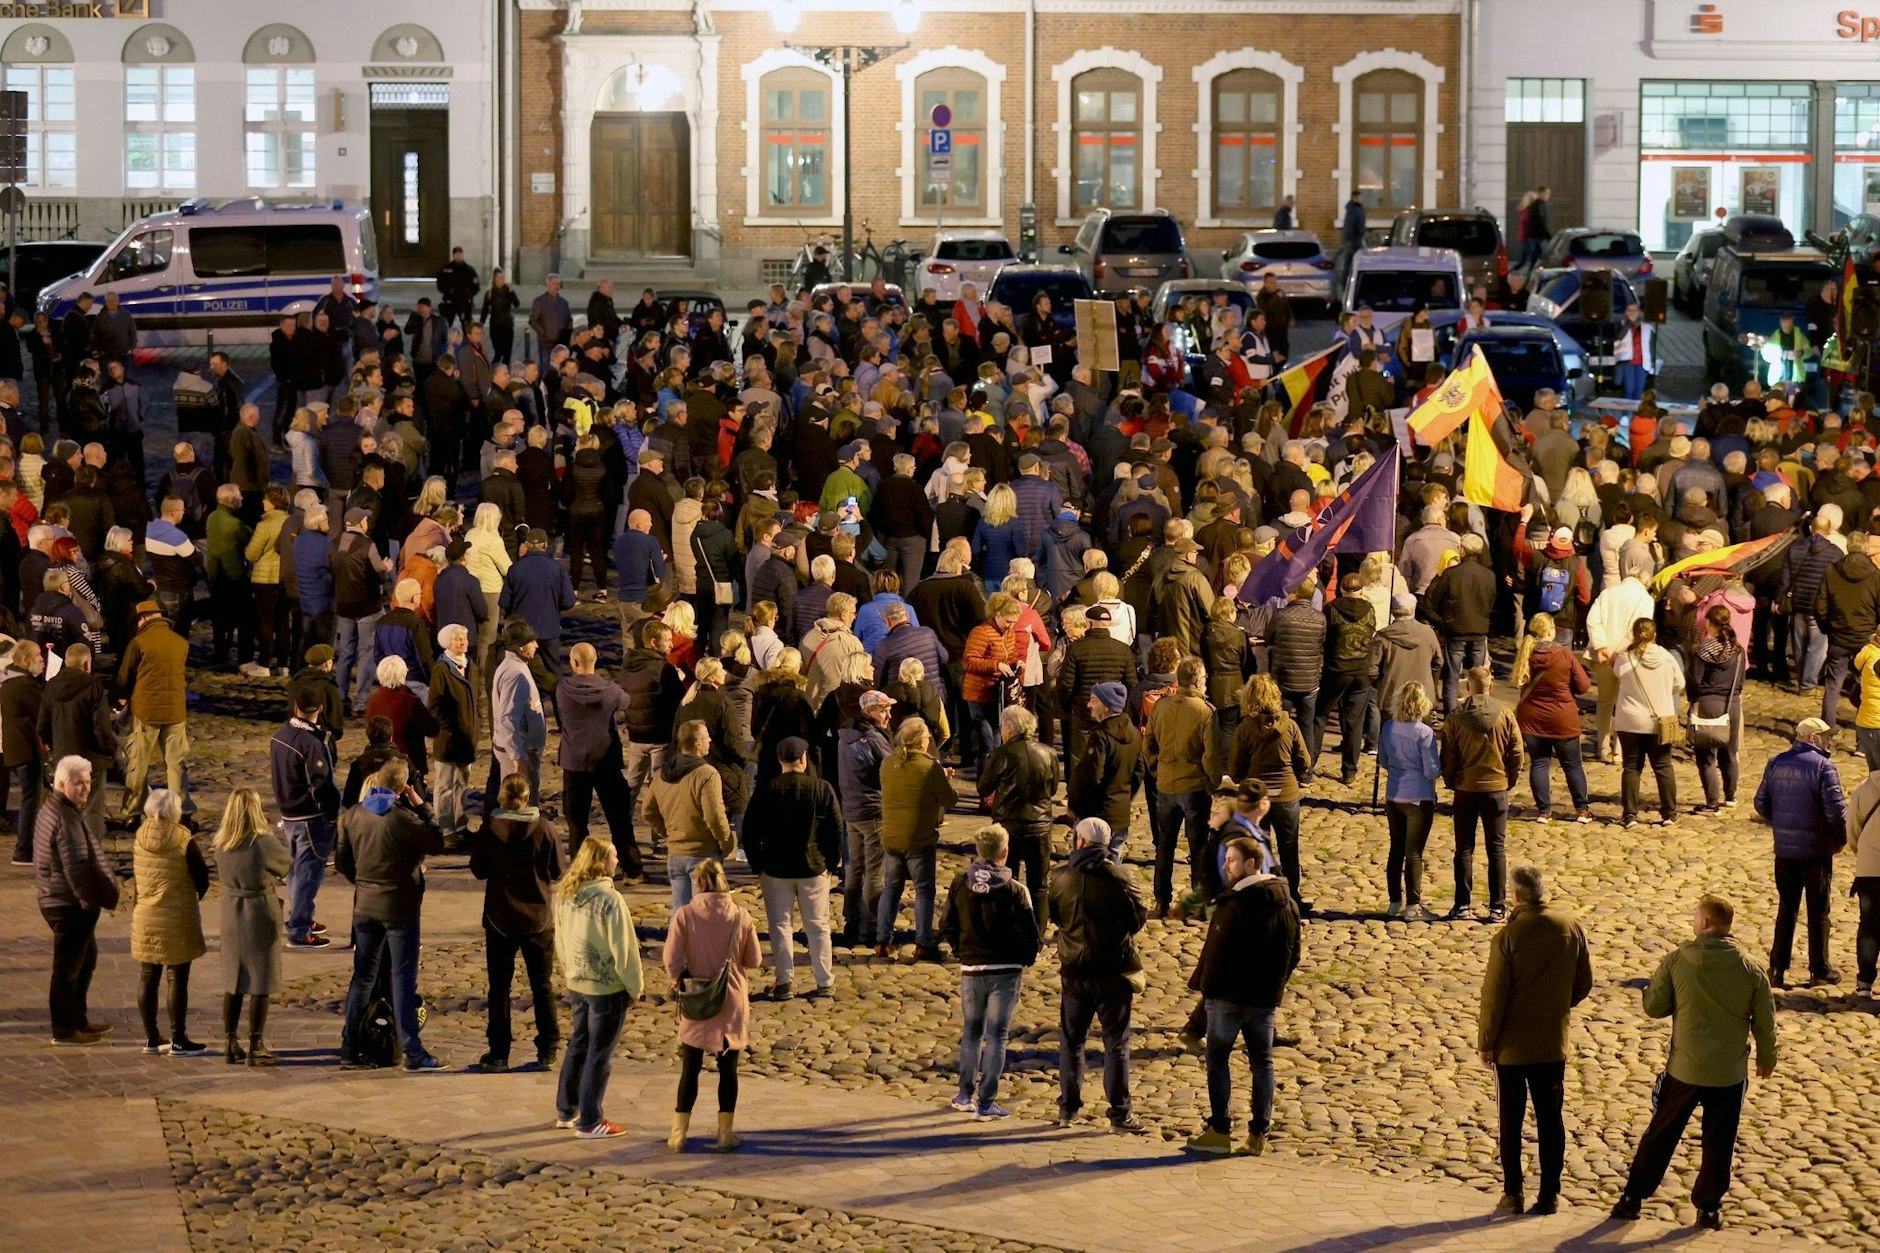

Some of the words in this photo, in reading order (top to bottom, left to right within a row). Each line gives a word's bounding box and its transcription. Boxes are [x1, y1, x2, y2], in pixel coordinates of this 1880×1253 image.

[46, 0, 103, 18] Bank
[1836, 10, 1880, 43] Sp
[935, 132, 947, 151] P
[203, 301, 248, 311] POLIZEI
